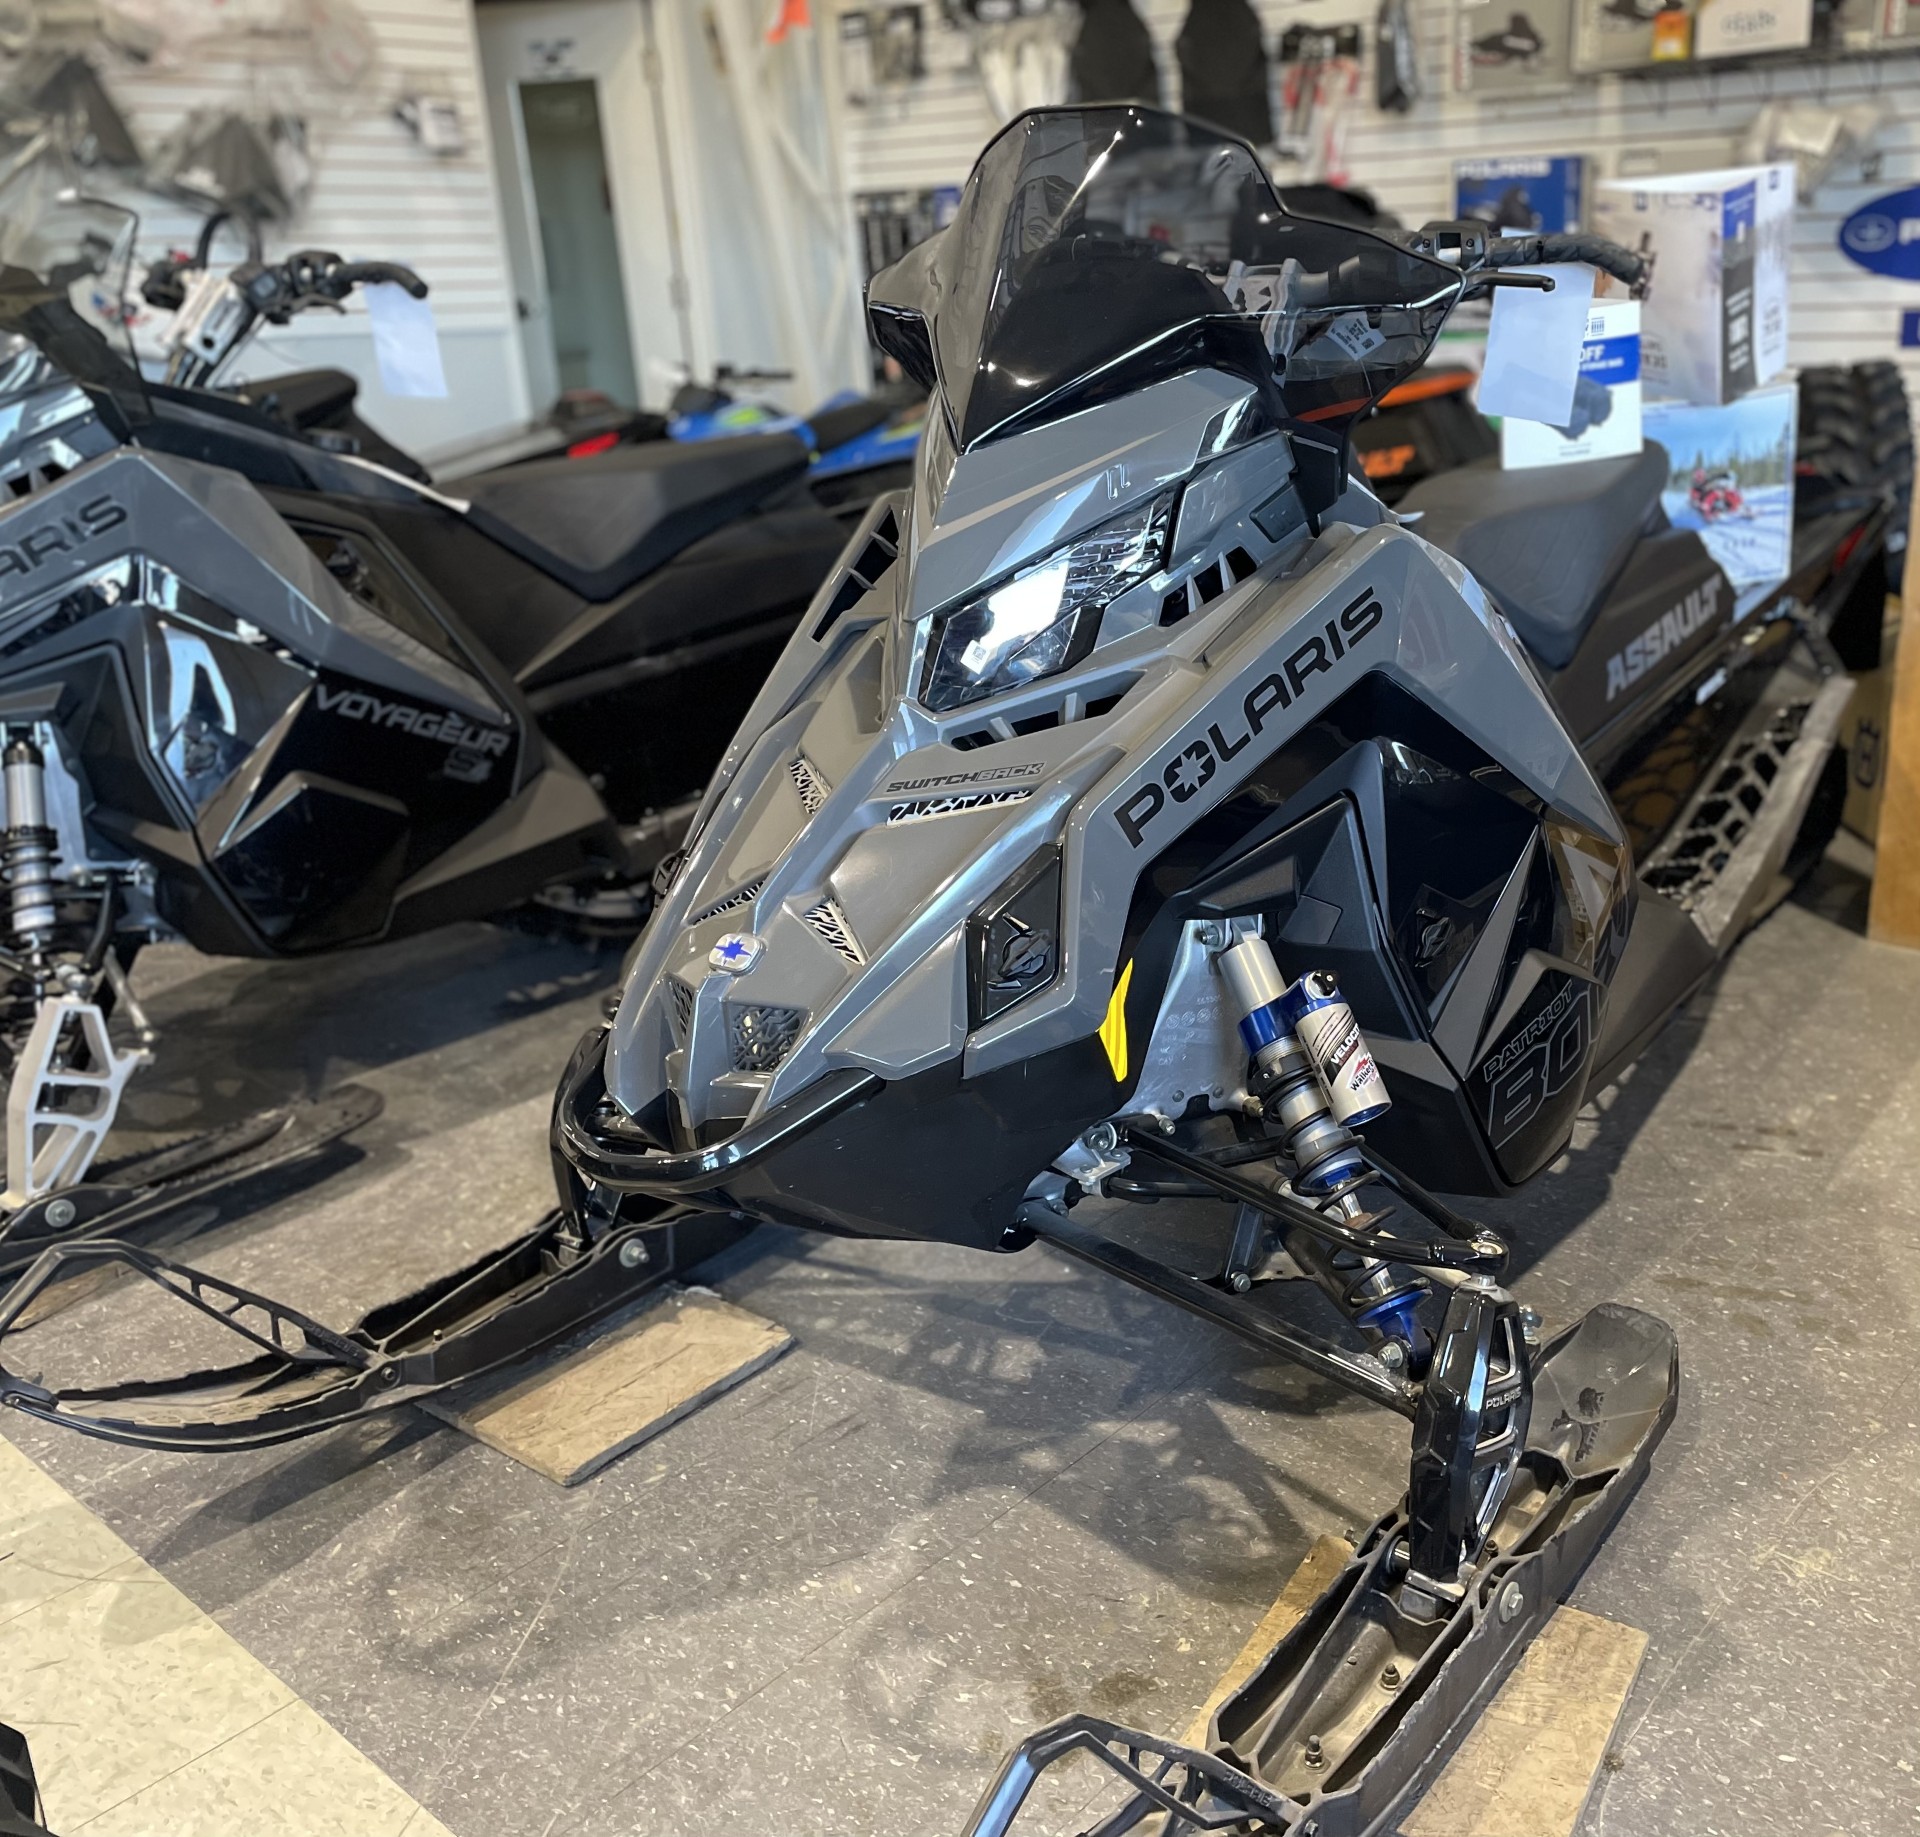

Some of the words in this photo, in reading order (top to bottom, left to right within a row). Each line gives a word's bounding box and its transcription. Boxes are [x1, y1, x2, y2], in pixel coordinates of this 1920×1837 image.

[1605, 573, 1722, 702] ASSAULT
[1113, 586, 1383, 849] POLARIS
[886, 762, 1045, 793] SWITCHBACK
[1484, 979, 1573, 1083] PATRIOT
[1486, 1386, 1522, 1410] POLARIS
